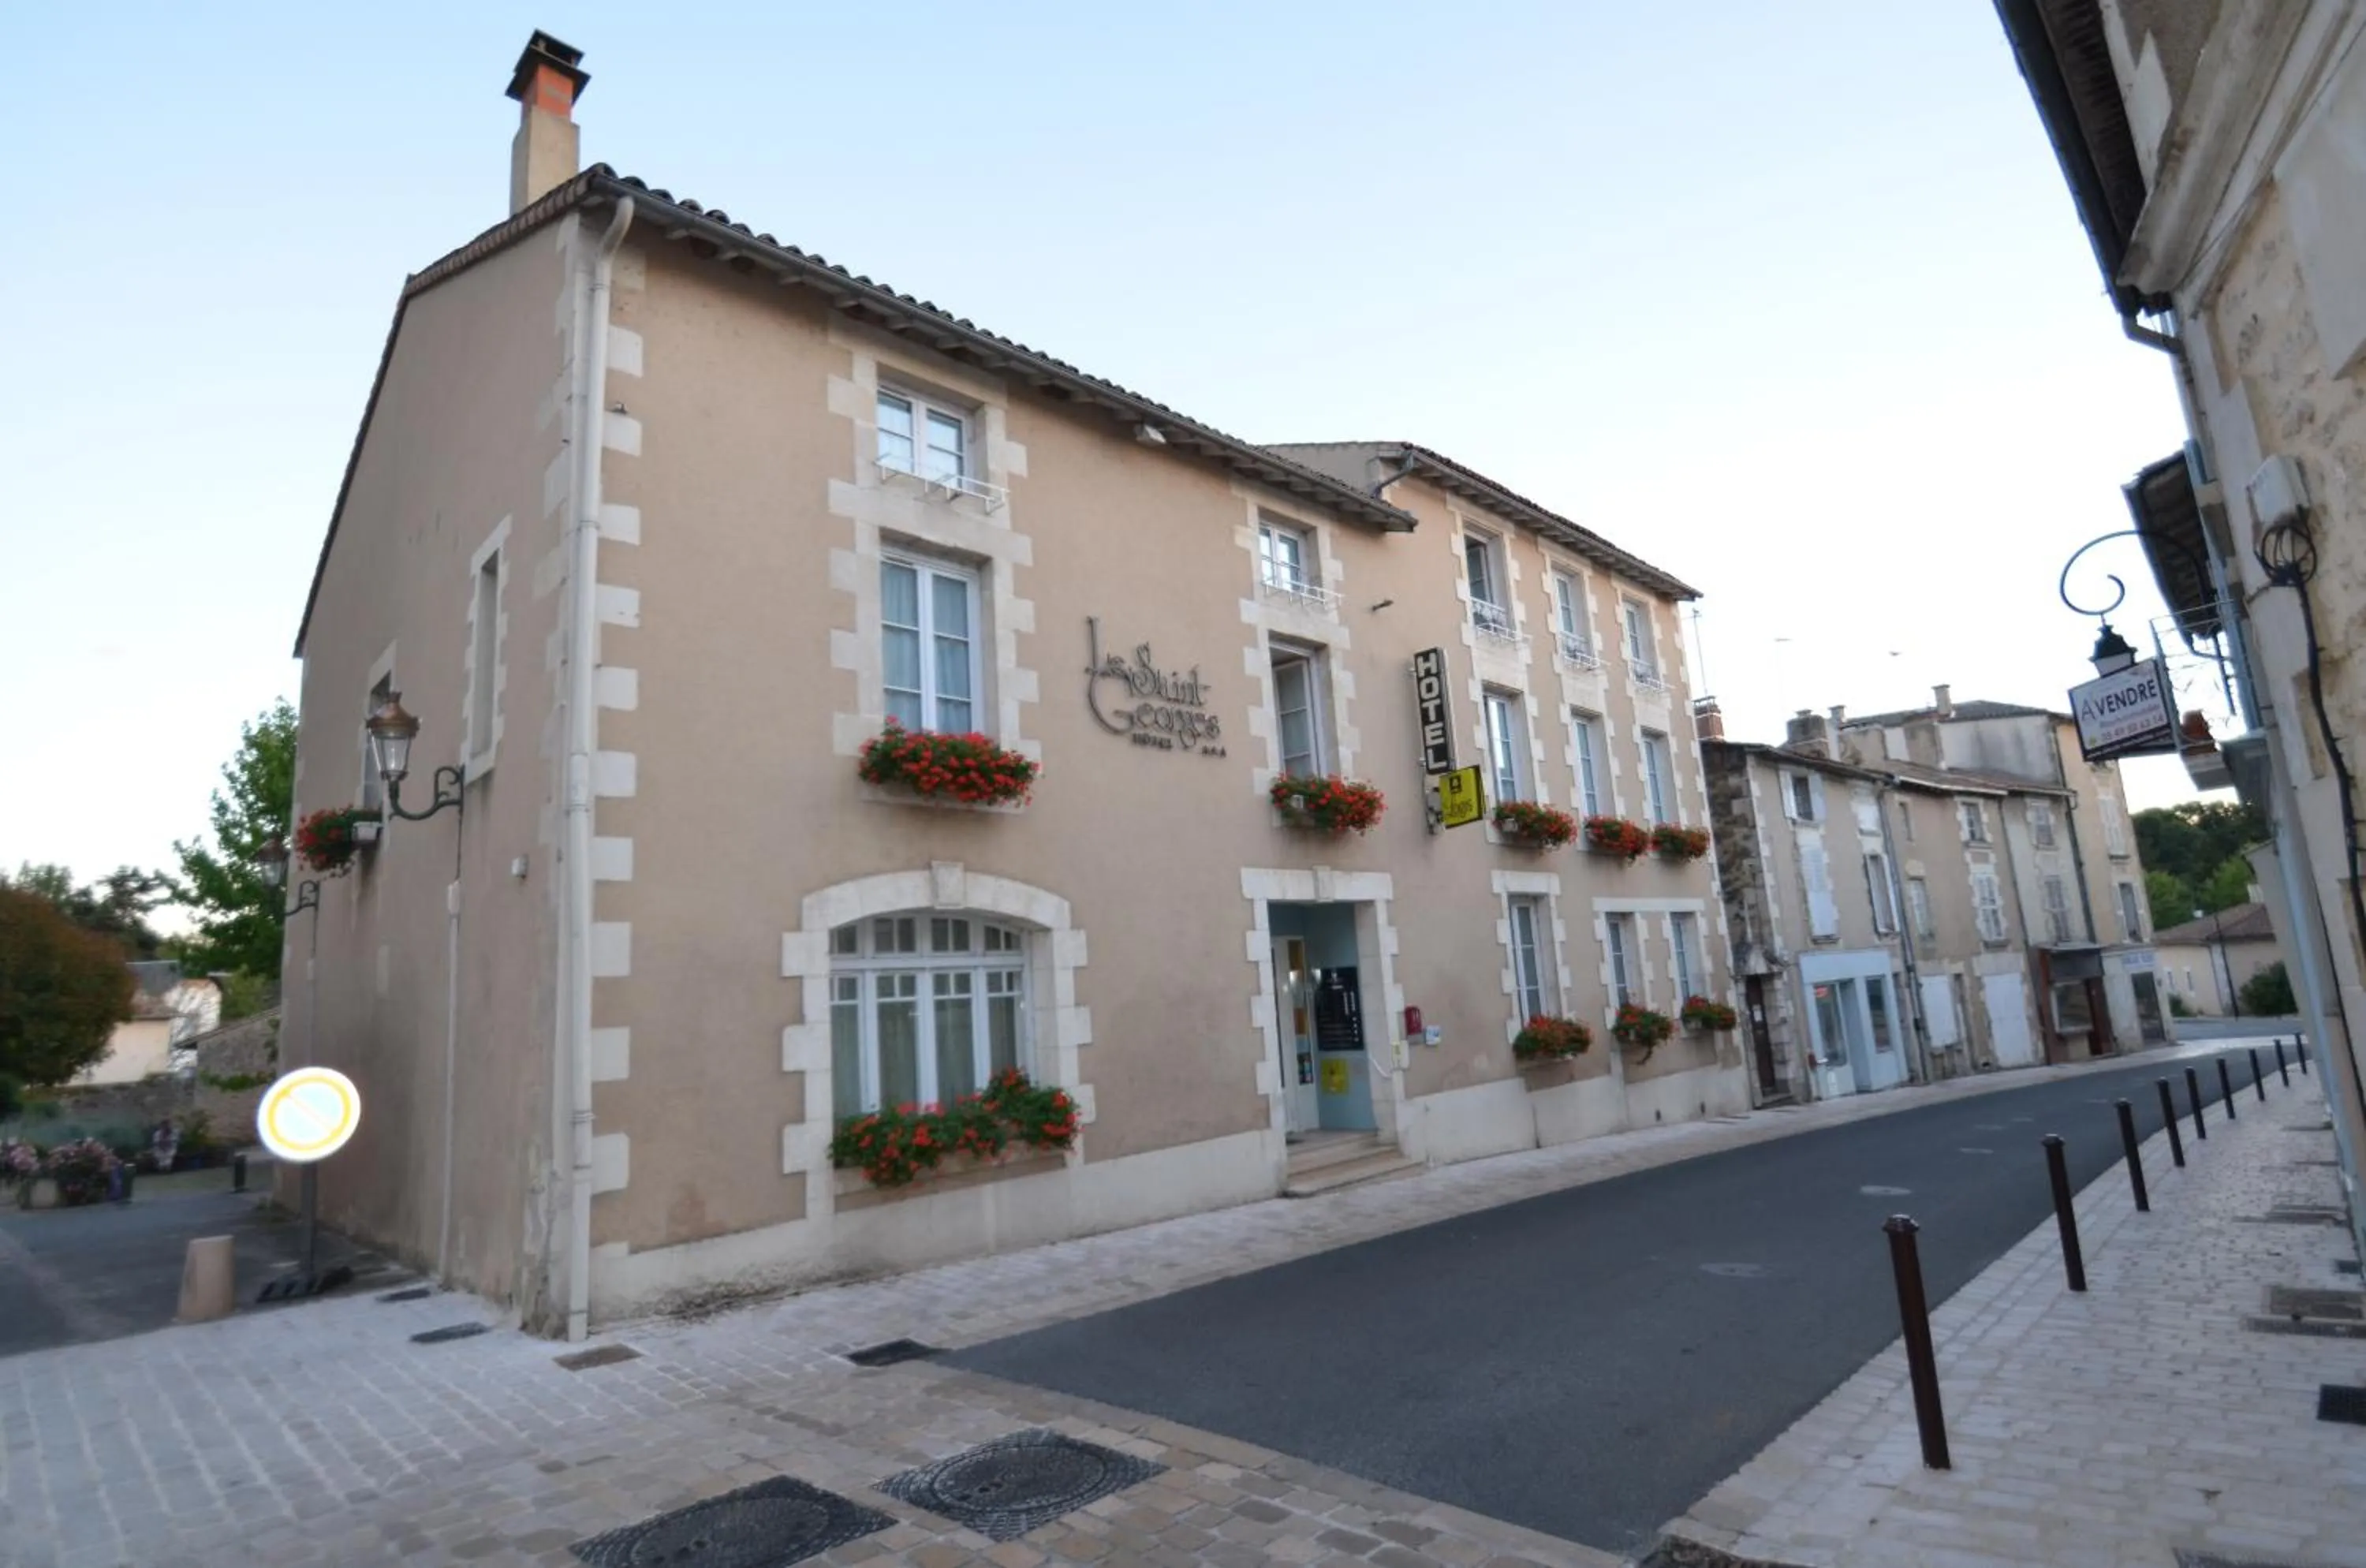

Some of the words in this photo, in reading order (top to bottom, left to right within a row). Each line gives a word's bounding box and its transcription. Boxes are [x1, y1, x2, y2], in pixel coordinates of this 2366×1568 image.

[1088, 670, 1222, 749] Georges
[1132, 642, 1211, 707] Saint
[2095, 679, 2158, 715] VENDRE
[1416, 653, 1447, 770] HOTEL
